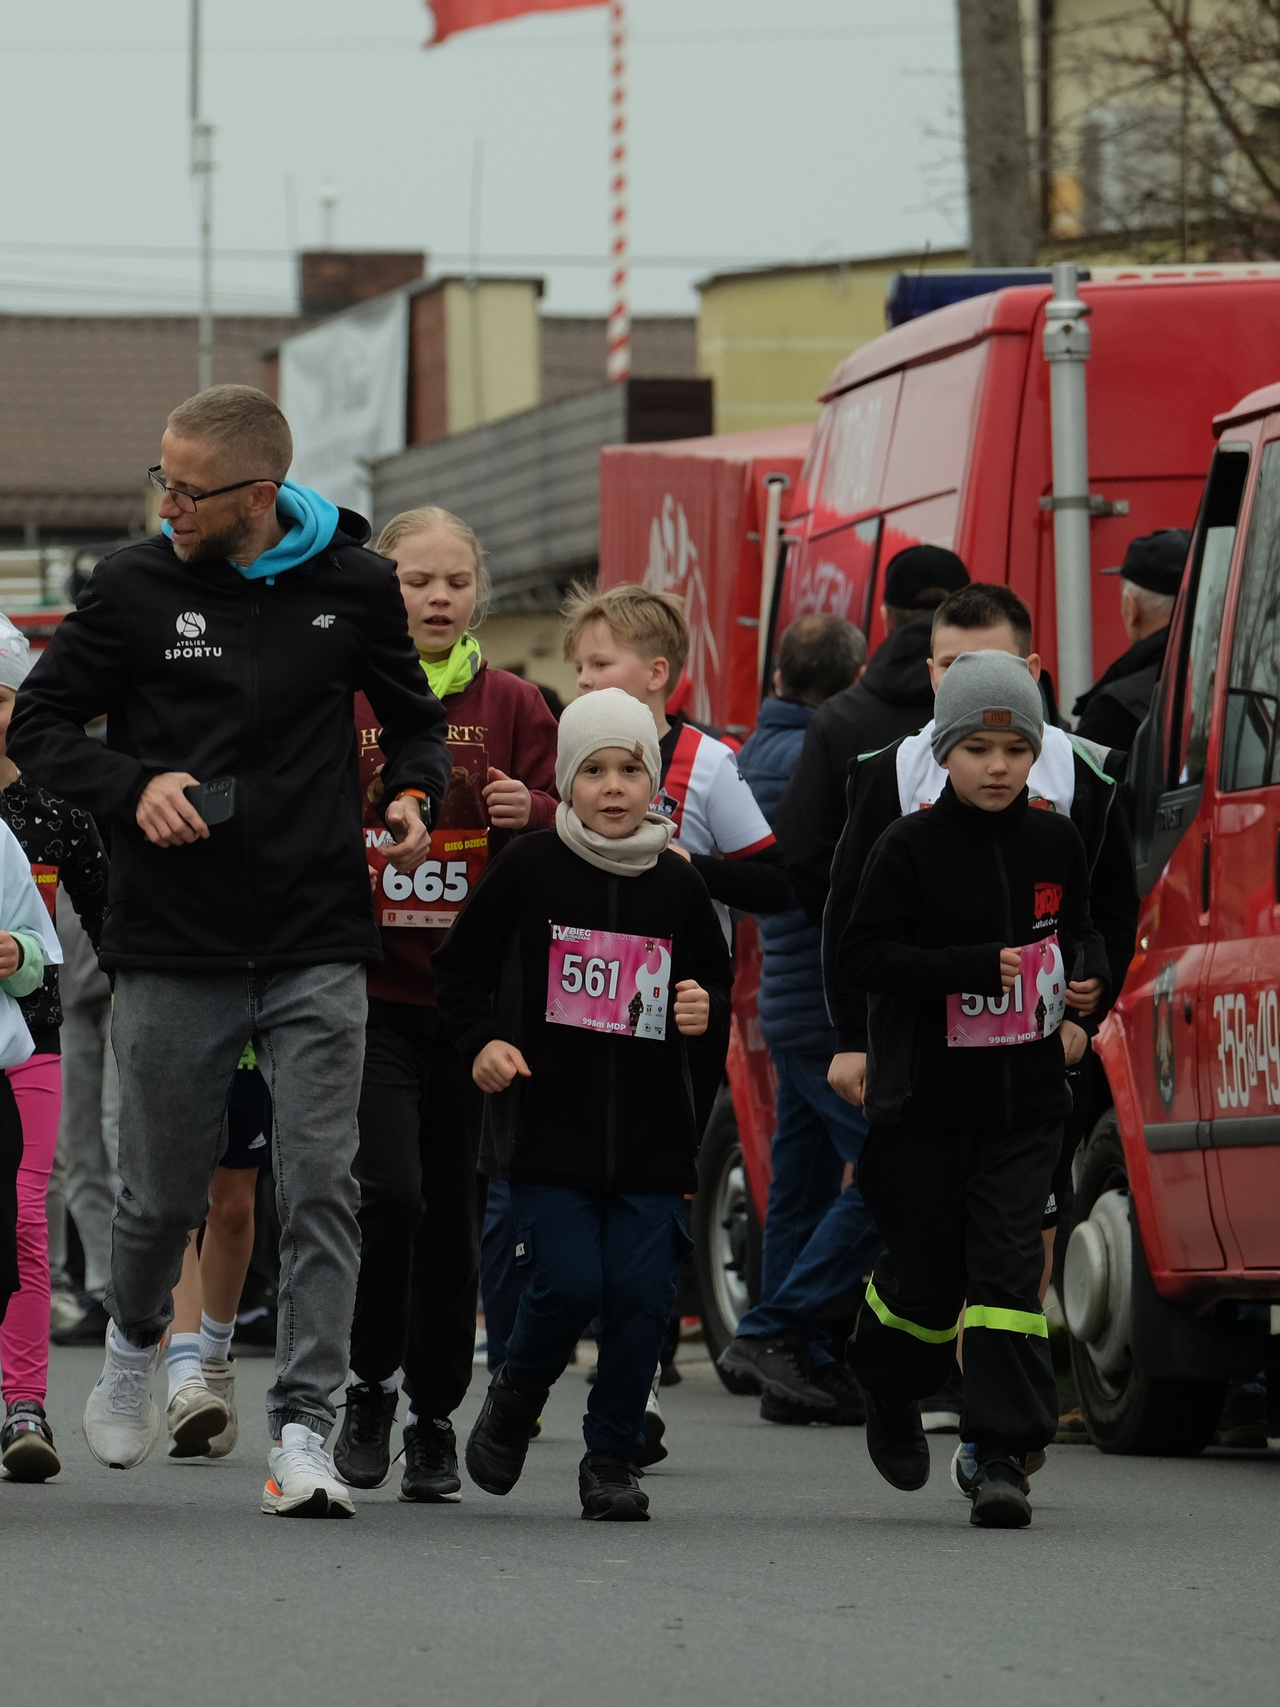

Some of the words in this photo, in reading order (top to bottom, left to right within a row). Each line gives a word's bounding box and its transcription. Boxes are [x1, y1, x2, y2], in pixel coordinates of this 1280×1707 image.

[312, 614, 336, 628] 4F
[165, 647, 222, 660] SPORTU
[445, 842, 463, 852] BIEG
[465, 838, 487, 849] DZIECI
[382, 860, 469, 902] 665
[552, 925, 570, 941] IV
[569, 927, 592, 937] BIEG
[561, 953, 620, 999] 561
[582, 1017, 605, 1028] 998m
[606, 1021, 627, 1031] MDP
[988, 1034, 1015, 1044] 998m
[1017, 1031, 1037, 1041] MDP
